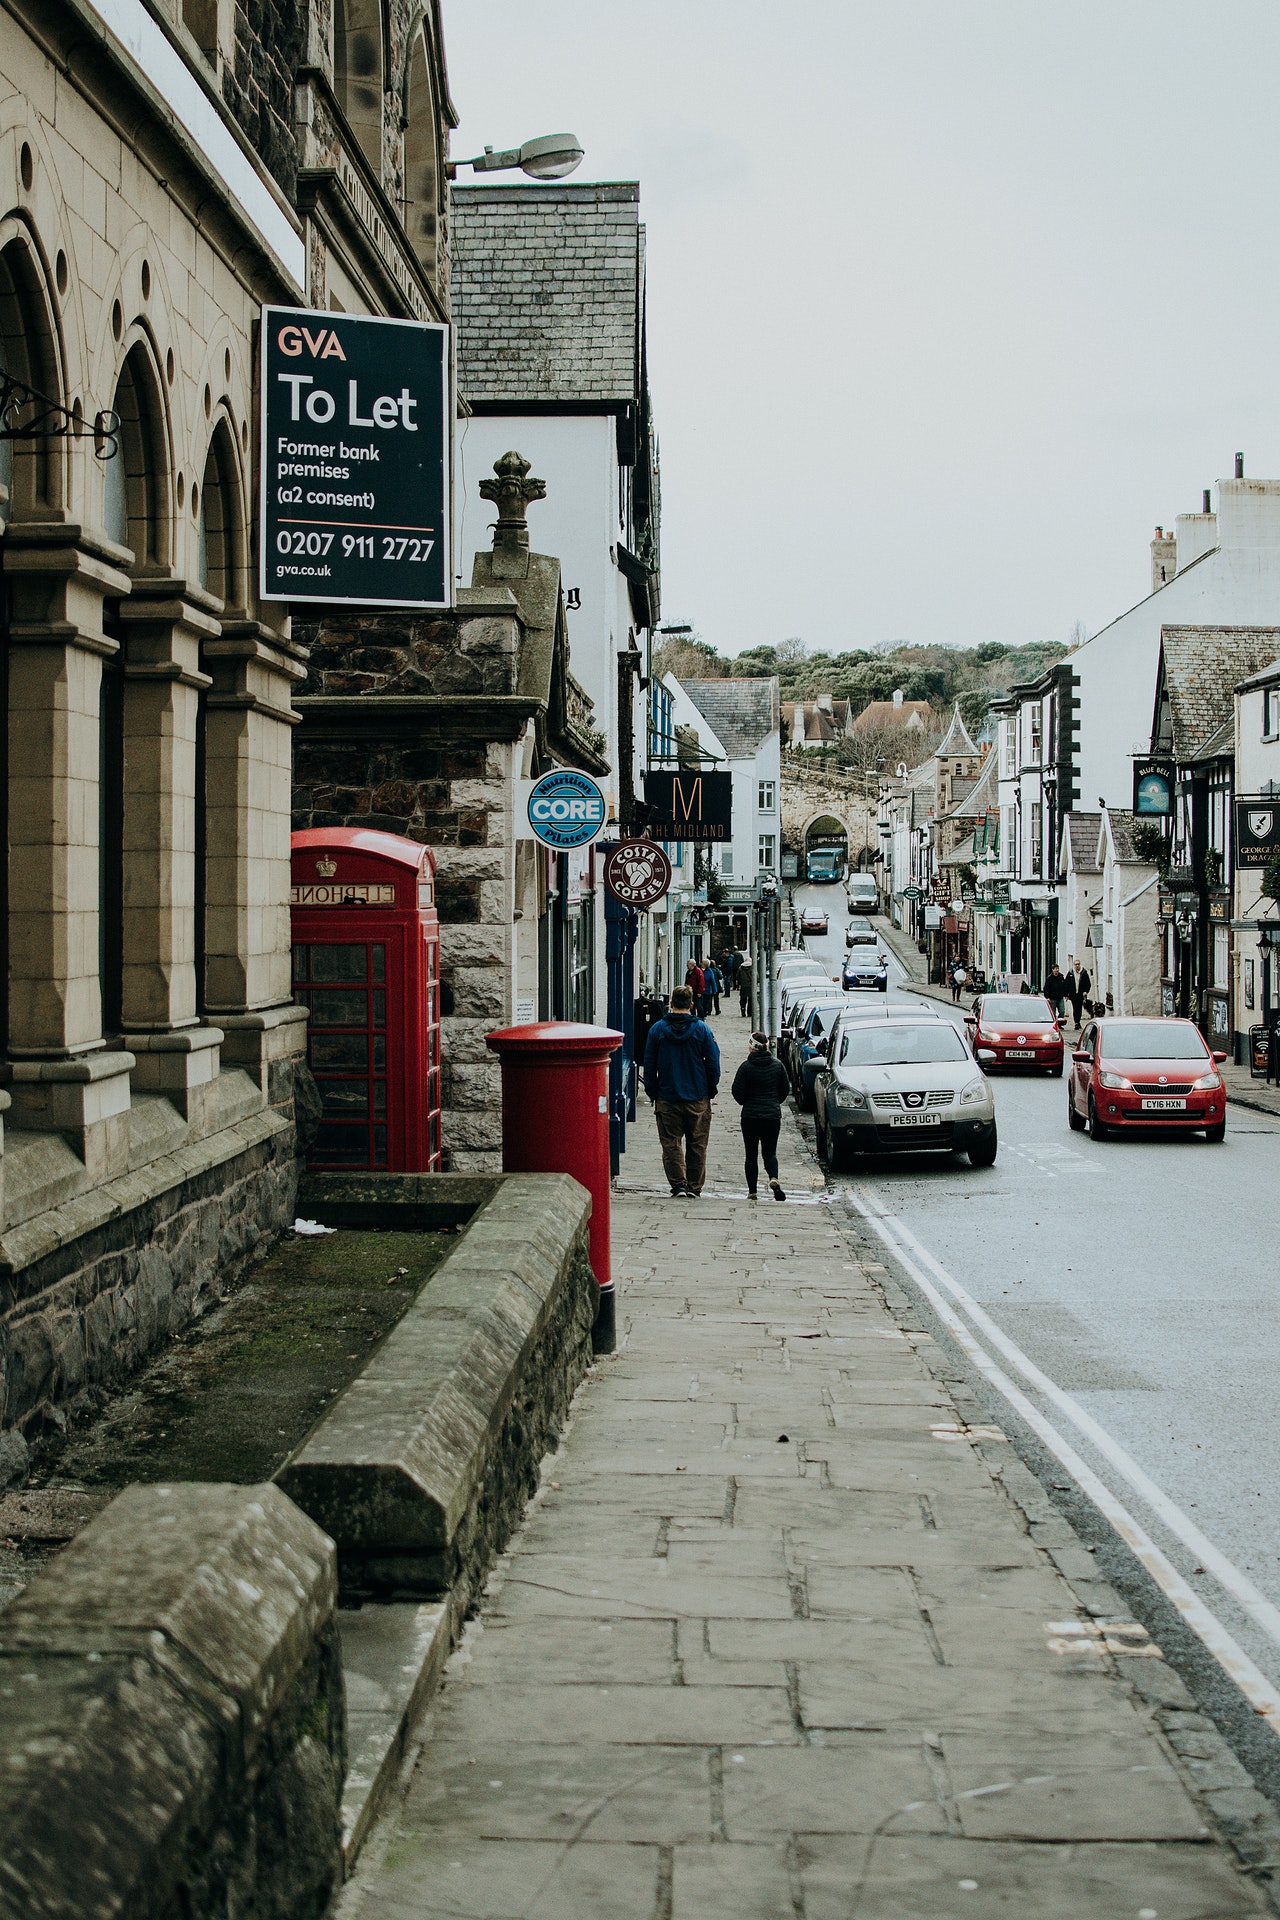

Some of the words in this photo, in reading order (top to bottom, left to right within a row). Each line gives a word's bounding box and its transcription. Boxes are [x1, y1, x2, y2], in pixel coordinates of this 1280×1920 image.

[278, 326, 347, 361] GVA
[277, 373, 336, 424] To
[348, 379, 418, 431] Let
[277, 437, 335, 458] Former
[339, 441, 380, 461] bank
[277, 461, 350, 480] premises
[277, 486, 303, 504] (a2
[306, 491, 375, 510] consent)
[276, 530, 335, 556] 0207
[341, 534, 374, 559] 911
[382, 536, 435, 562] 2727
[276, 564, 332, 578] gva.co.uk
[1139, 766, 1154, 776] BLUE
[1156, 766, 1169, 777] BELL
[538, 774, 592, 795] Nutrition
[672, 777, 702, 821] M
[532, 799, 600, 820] CORE
[544, 829, 589, 844] Pilates
[673, 823, 724, 838] MIDLAND
[616, 846, 657, 864] COSTA
[1240, 846, 1271, 854] GEORGE
[1247, 854, 1277, 862] DRAGO
[614, 878, 663, 900] COFFEE
[1146, 1100, 1164, 1108] CY16
[1165, 1100, 1181, 1108] HXN
[893, 1115, 918, 1125] PE59
[919, 1114, 937, 1124] UGT
